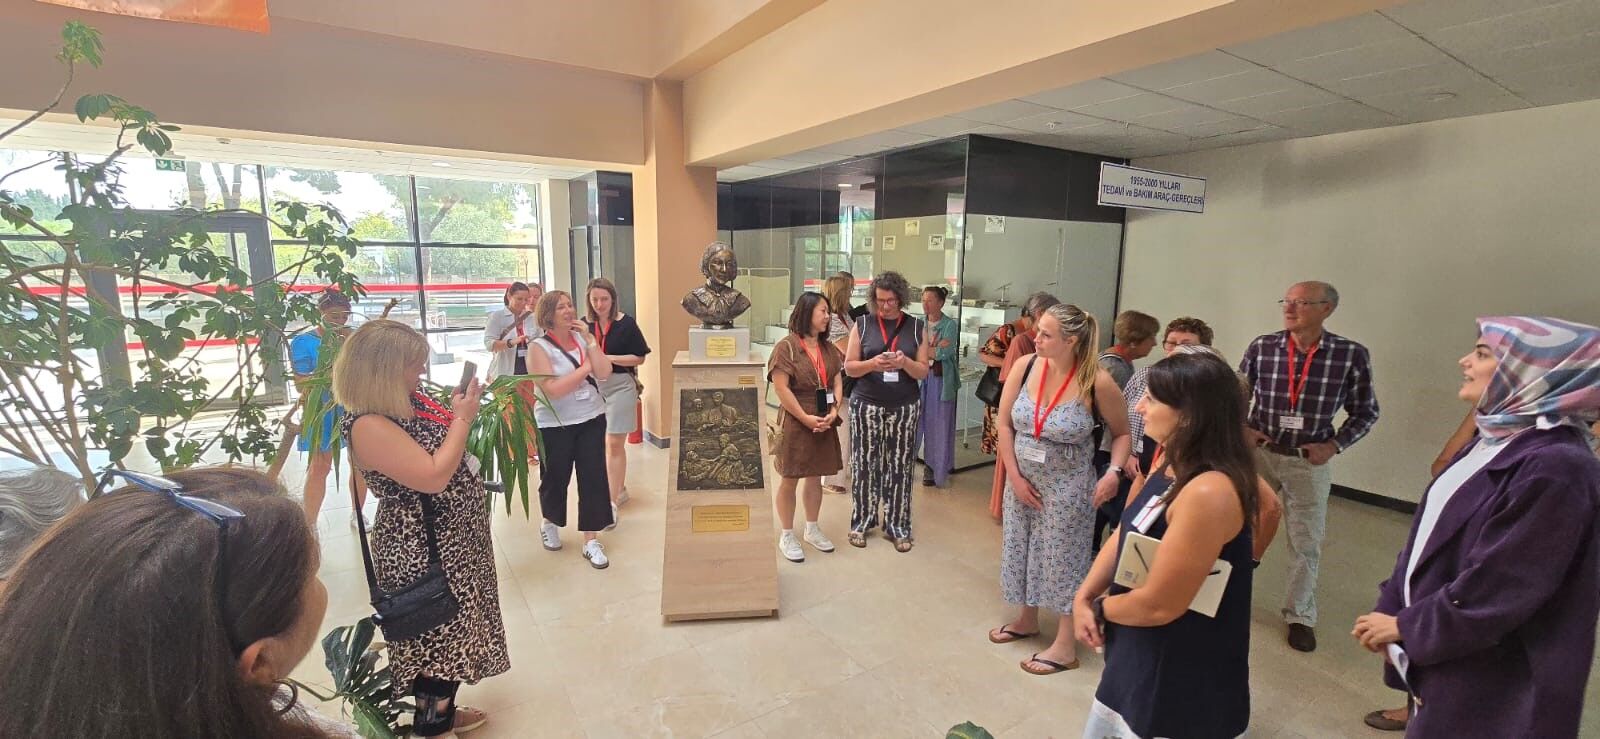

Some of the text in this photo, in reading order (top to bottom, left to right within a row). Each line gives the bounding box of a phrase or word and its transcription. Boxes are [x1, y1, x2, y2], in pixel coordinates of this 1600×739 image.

[1103, 184, 1125, 196] TEDAVİ
[1133, 188, 1153, 199] BAKIM
[1158, 179, 1181, 191] YILLARI
